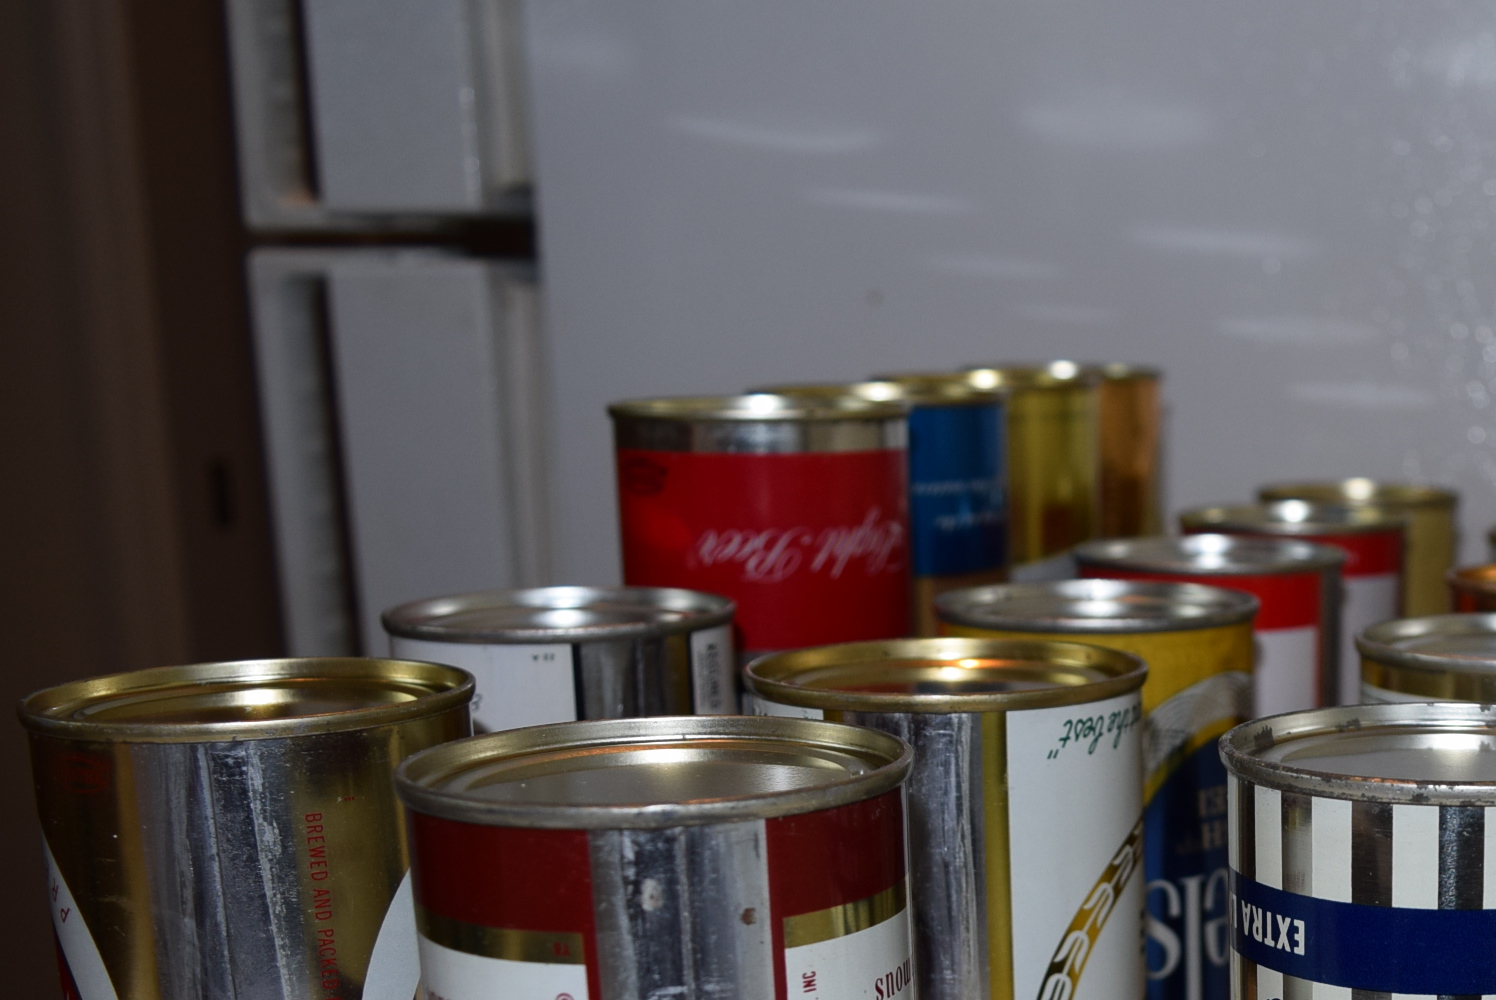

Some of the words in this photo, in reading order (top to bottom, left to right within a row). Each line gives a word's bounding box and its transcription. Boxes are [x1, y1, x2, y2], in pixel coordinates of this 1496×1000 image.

[696, 525, 804, 583] Beer
[305, 812, 328, 882] BREWED
[313, 888, 332, 922] AND
[1241, 900, 1305, 956] EXTRA
[317, 928, 339, 990] PACKED
